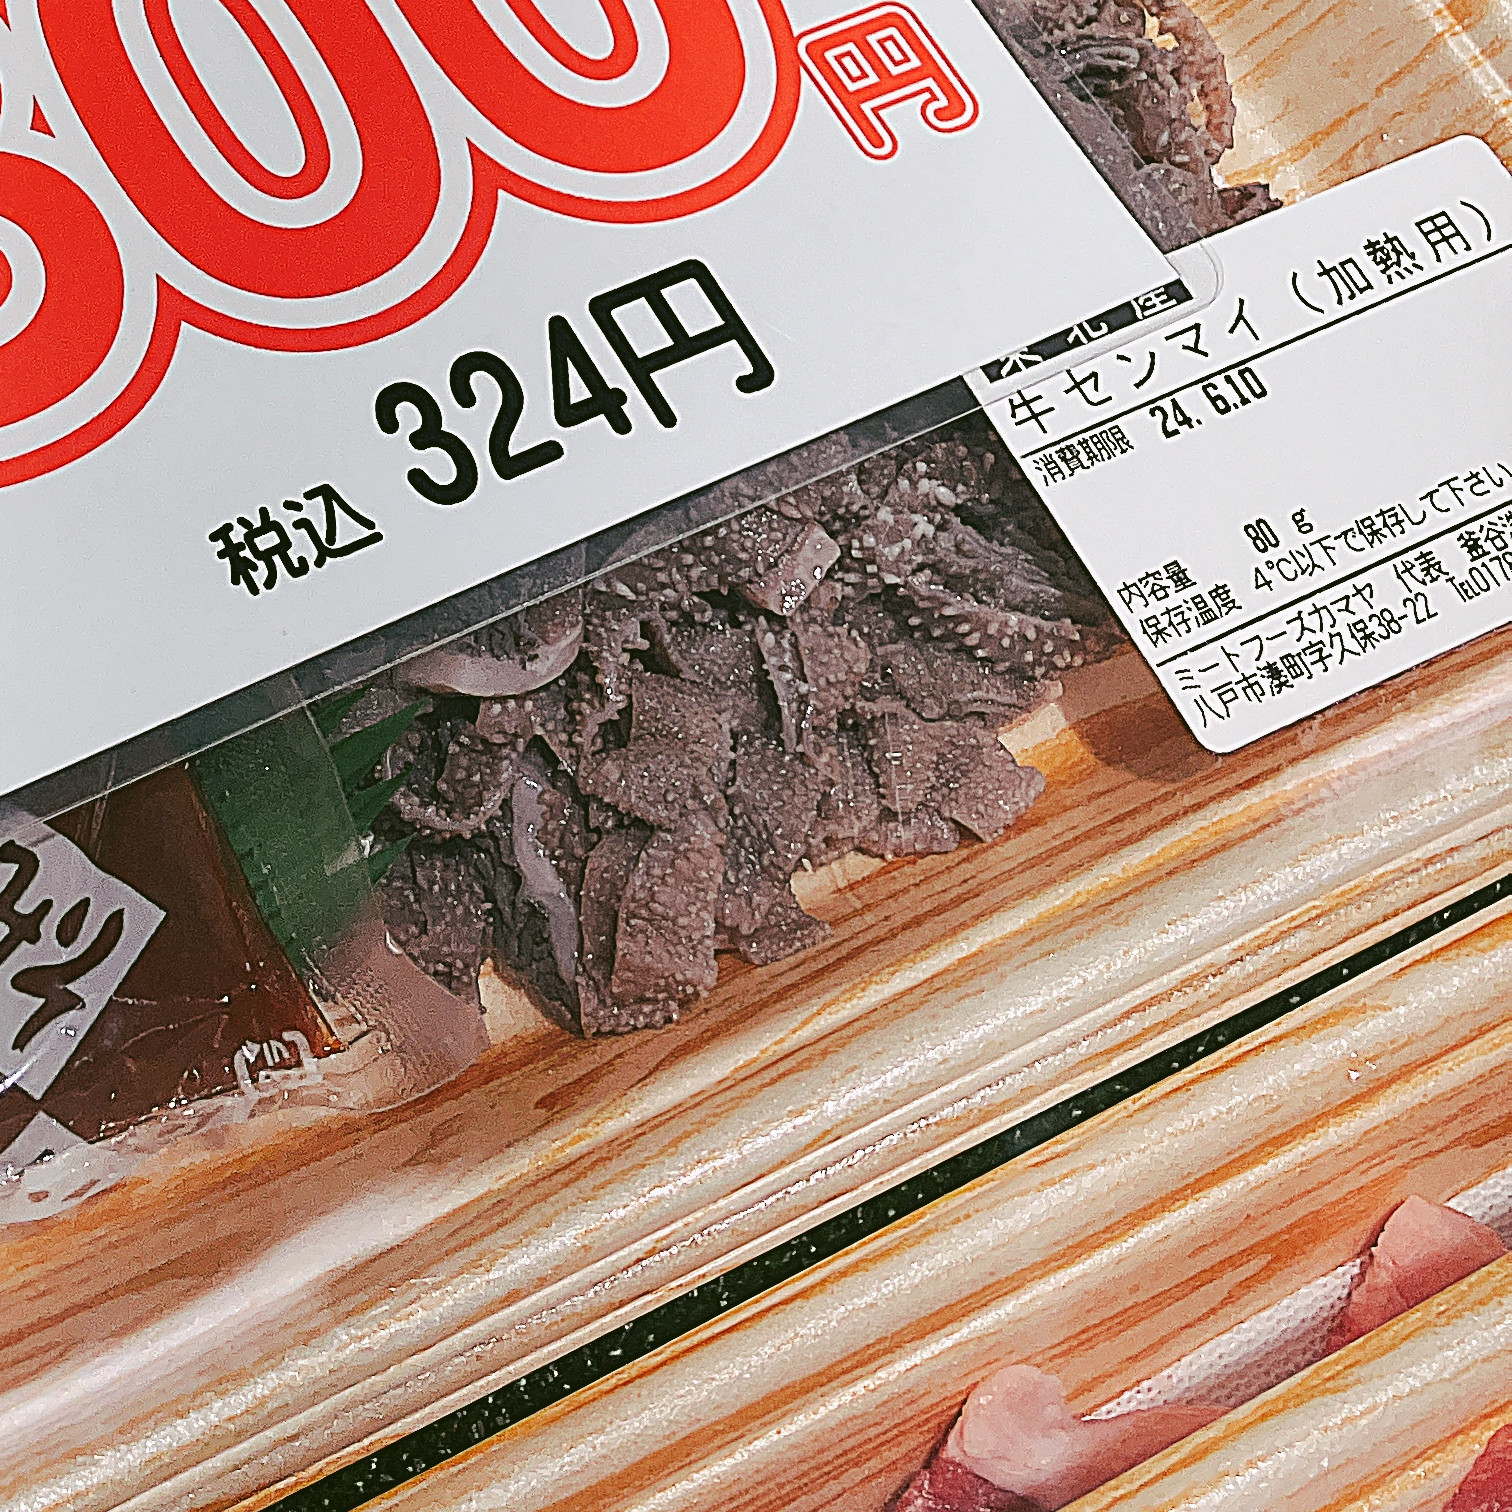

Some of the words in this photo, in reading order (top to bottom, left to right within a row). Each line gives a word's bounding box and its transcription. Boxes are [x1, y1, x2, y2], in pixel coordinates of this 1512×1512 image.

[209, 484, 383, 596] 税込
[375, 259, 775, 506] 324円
[1033, 425, 1134, 486] 消費期限
[1117, 560, 1197, 613] 内容量
[1393, 550, 1450, 593] 代表
[1139, 583, 1243, 648] 保存温度
